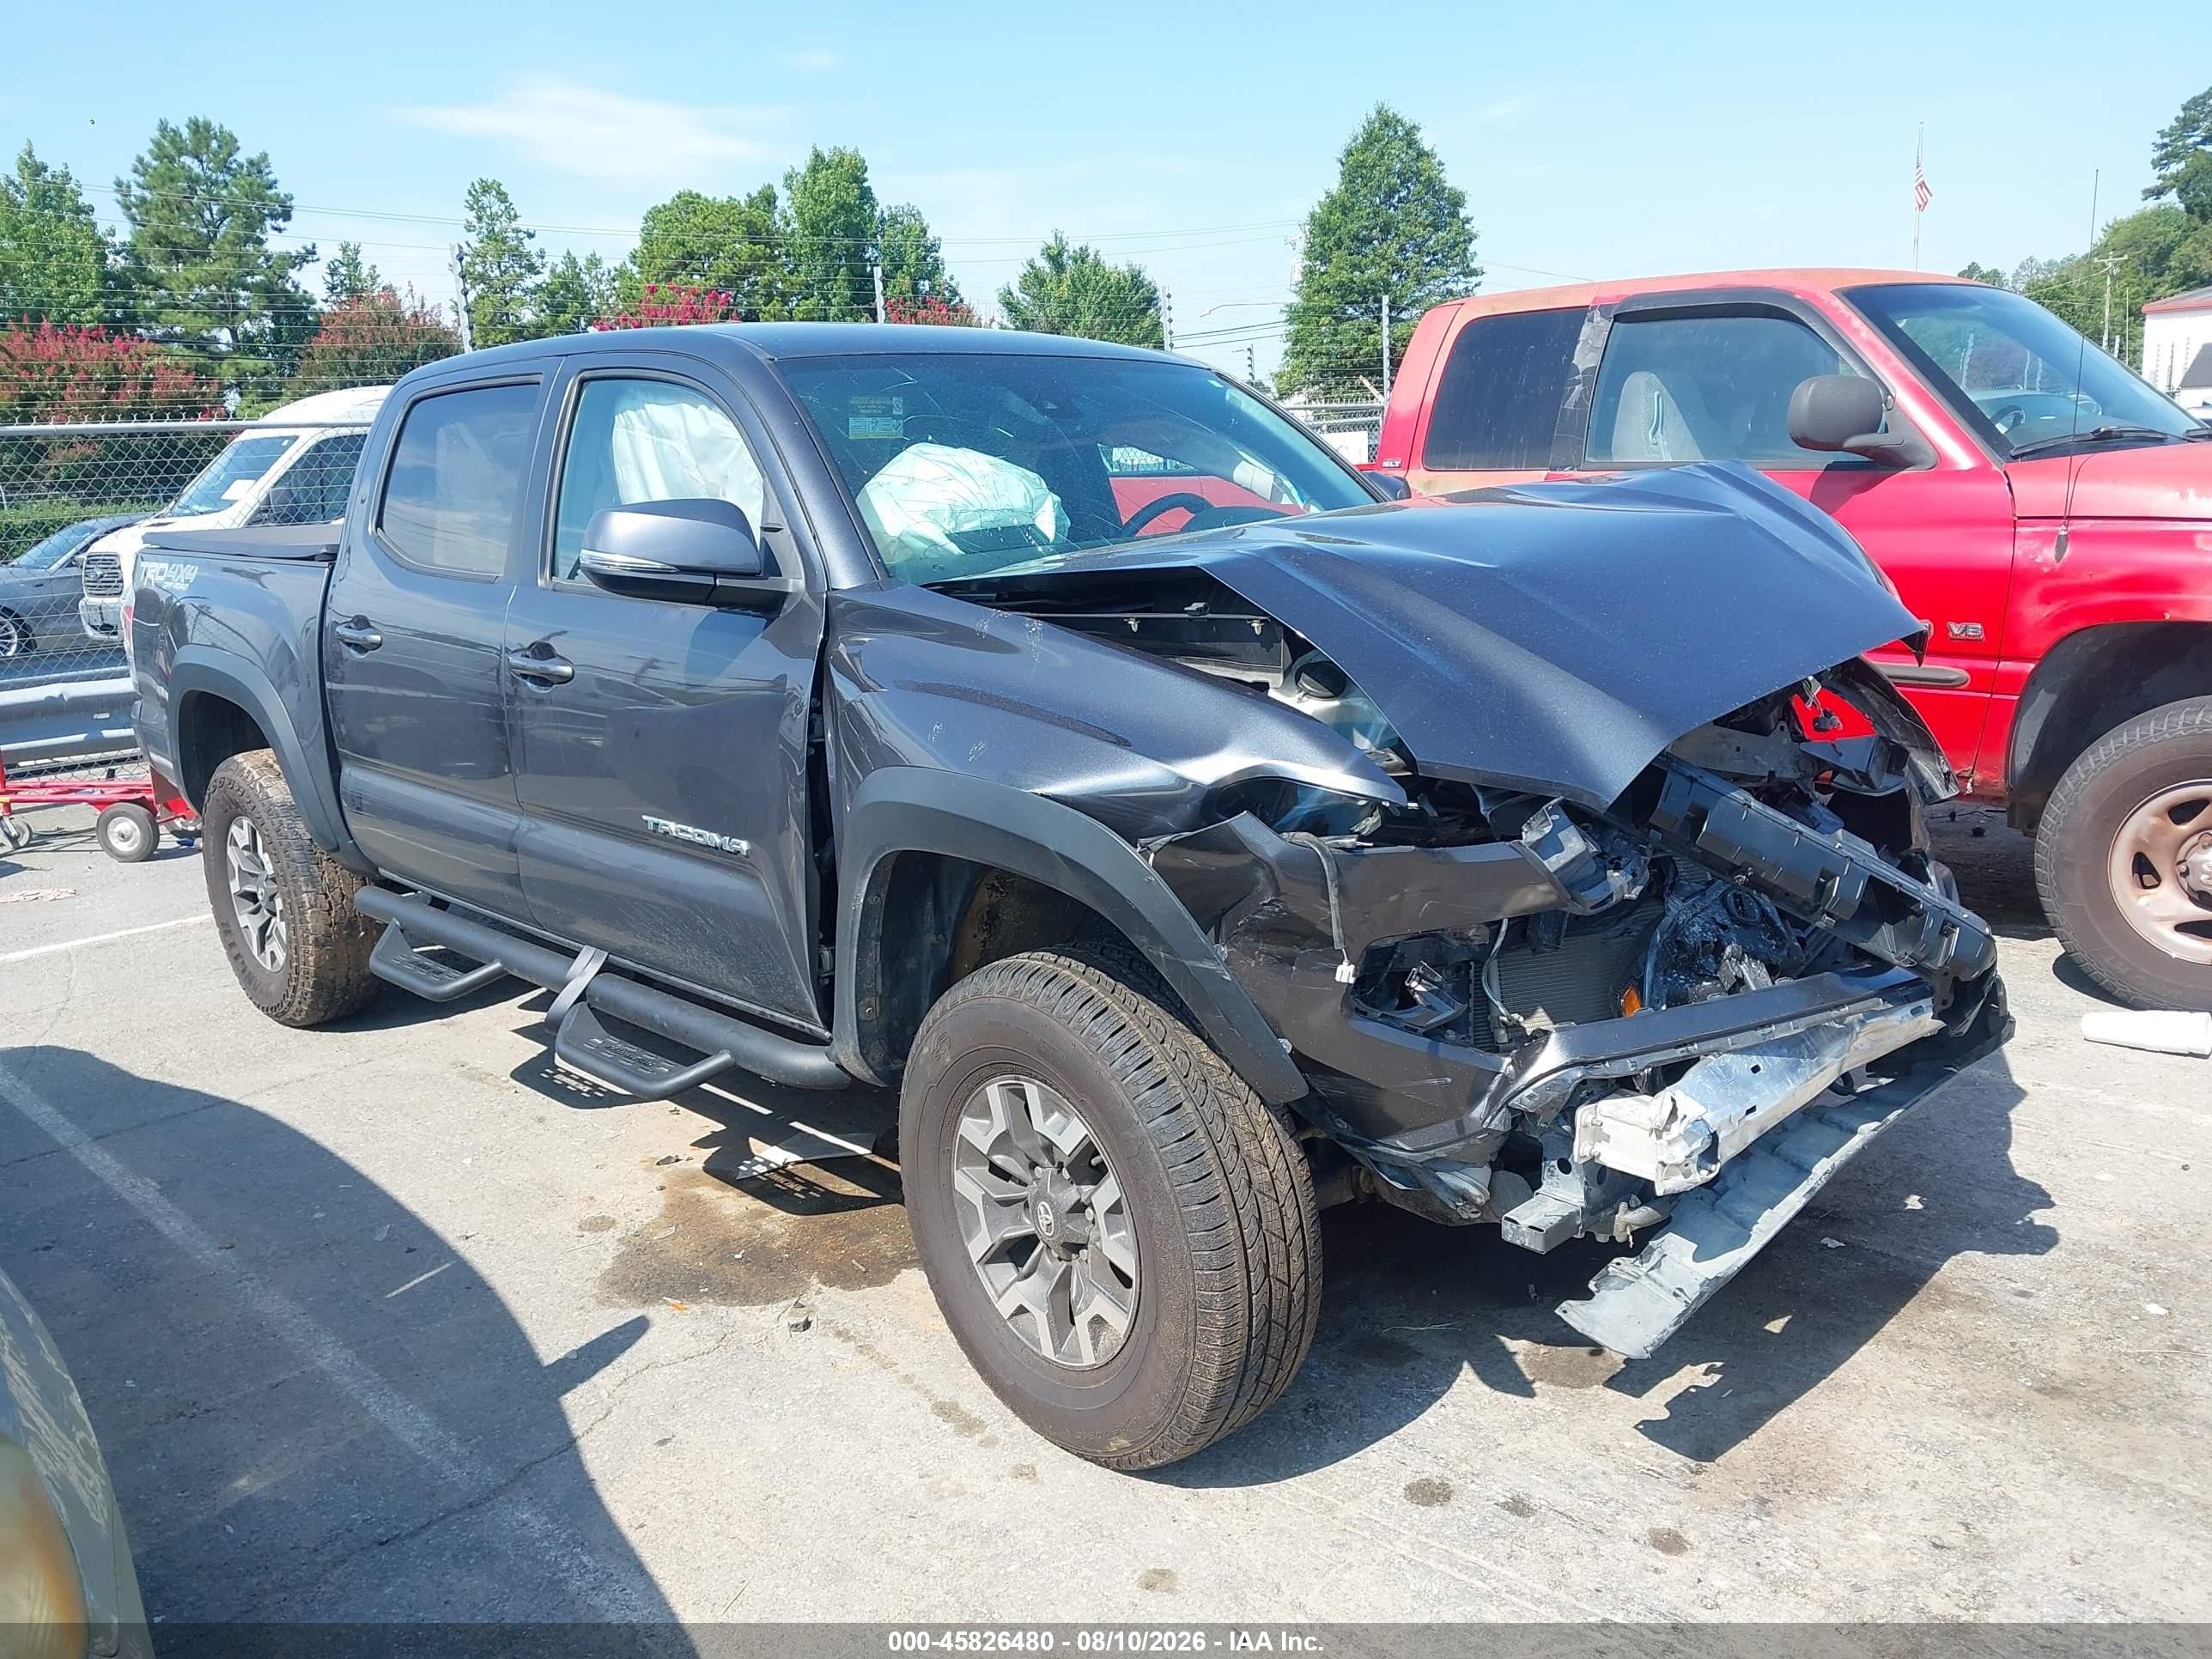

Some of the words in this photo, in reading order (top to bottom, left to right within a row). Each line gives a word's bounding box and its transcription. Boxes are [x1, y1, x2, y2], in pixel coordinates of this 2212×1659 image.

[141, 561, 169, 586] TRD
[1948, 623, 1982, 636] V8
[641, 814, 750, 856] TACOMA
